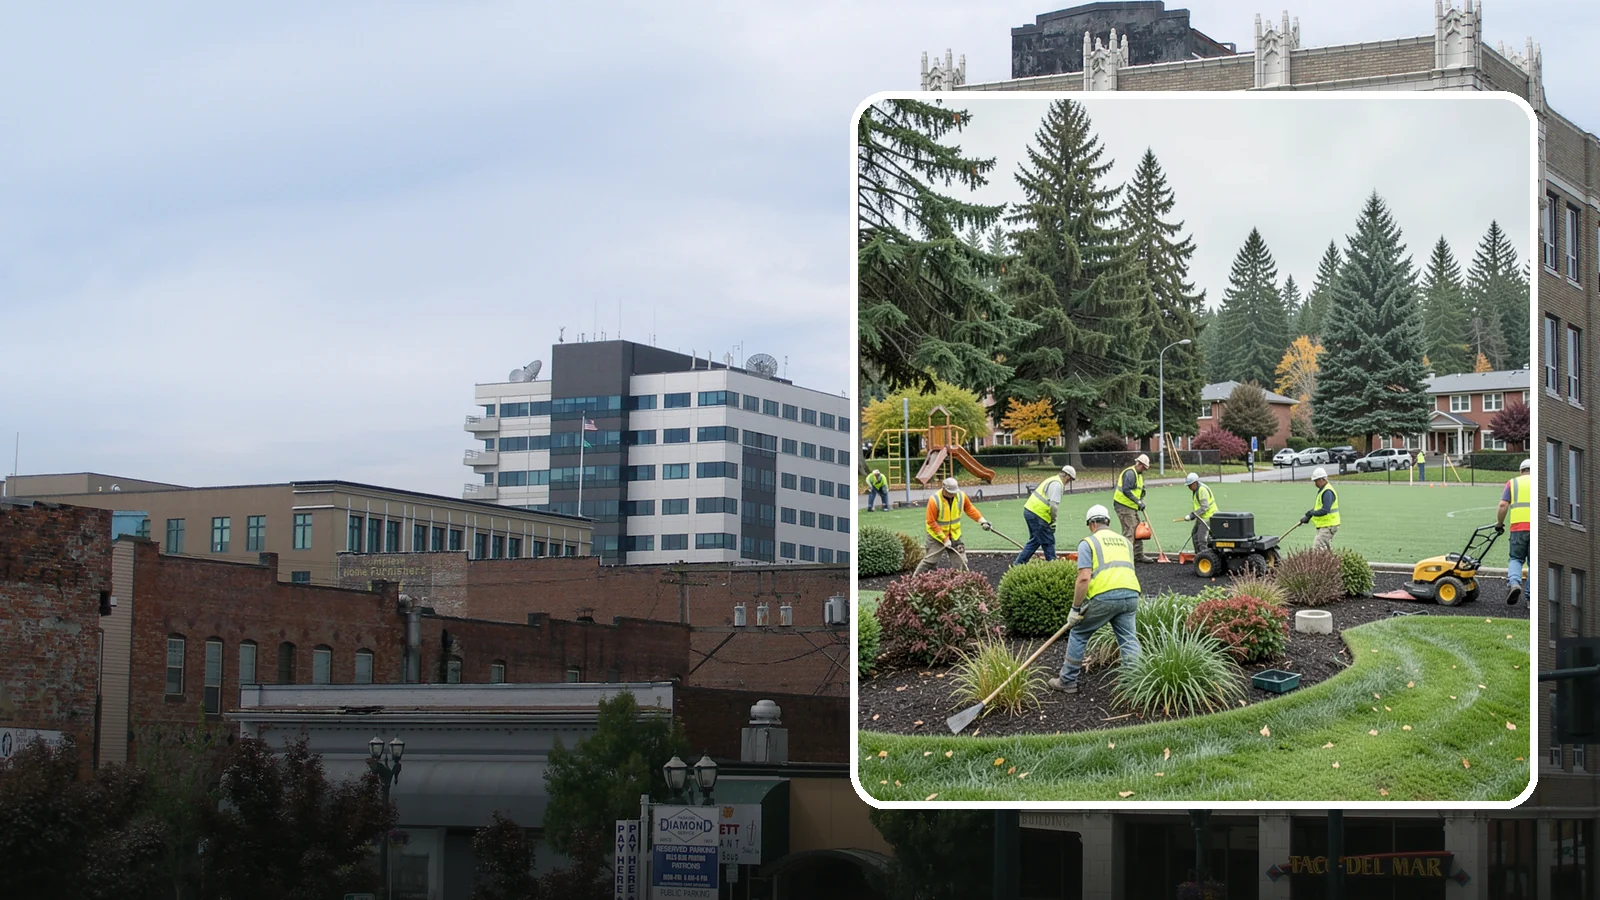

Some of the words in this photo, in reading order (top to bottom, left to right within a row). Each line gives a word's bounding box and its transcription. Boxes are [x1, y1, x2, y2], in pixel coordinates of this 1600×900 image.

[343, 567, 368, 577] Home
[370, 565, 427, 577] Furnishers
[660, 818, 713, 832] DIAMOND
[1021, 814, 1070, 828] BUILDING
[617, 824, 625, 852] PAY
[628, 824, 637, 852] PAY
[656, 845, 688, 853] RESERVED
[689, 846, 716, 854] PARKING
[721, 851, 739, 861] Soup
[671, 862, 701, 870] PATRONS
[1344, 856, 1384, 875] DEL
[1392, 857, 1442, 877] MAR
[616, 855, 625, 894] HERE
[627, 855, 636, 894] HERE
[660, 888, 682, 897] PUBLIC
[683, 889, 710, 898] PARKING
